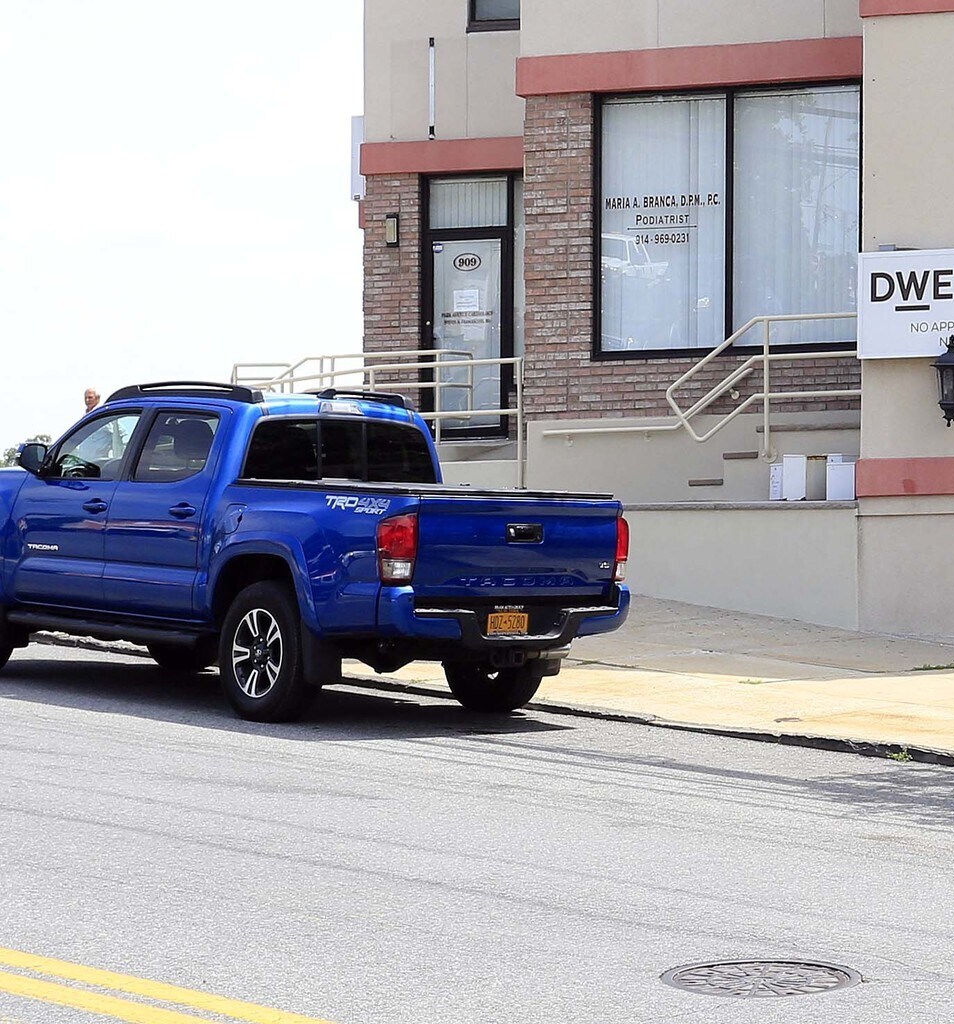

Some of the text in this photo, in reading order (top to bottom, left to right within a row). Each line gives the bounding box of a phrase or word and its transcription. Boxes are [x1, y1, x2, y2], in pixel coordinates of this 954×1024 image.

[605, 196, 631, 210] MARIA
[632, 196, 641, 208] A.
[707, 193, 721, 206] P.C.
[458, 257, 477, 267] 909
[910, 321, 929, 333] NO
[325, 495, 359, 511] TRD
[353, 506, 387, 515] SPORT
[460, 576, 575, 587] TACOMA
